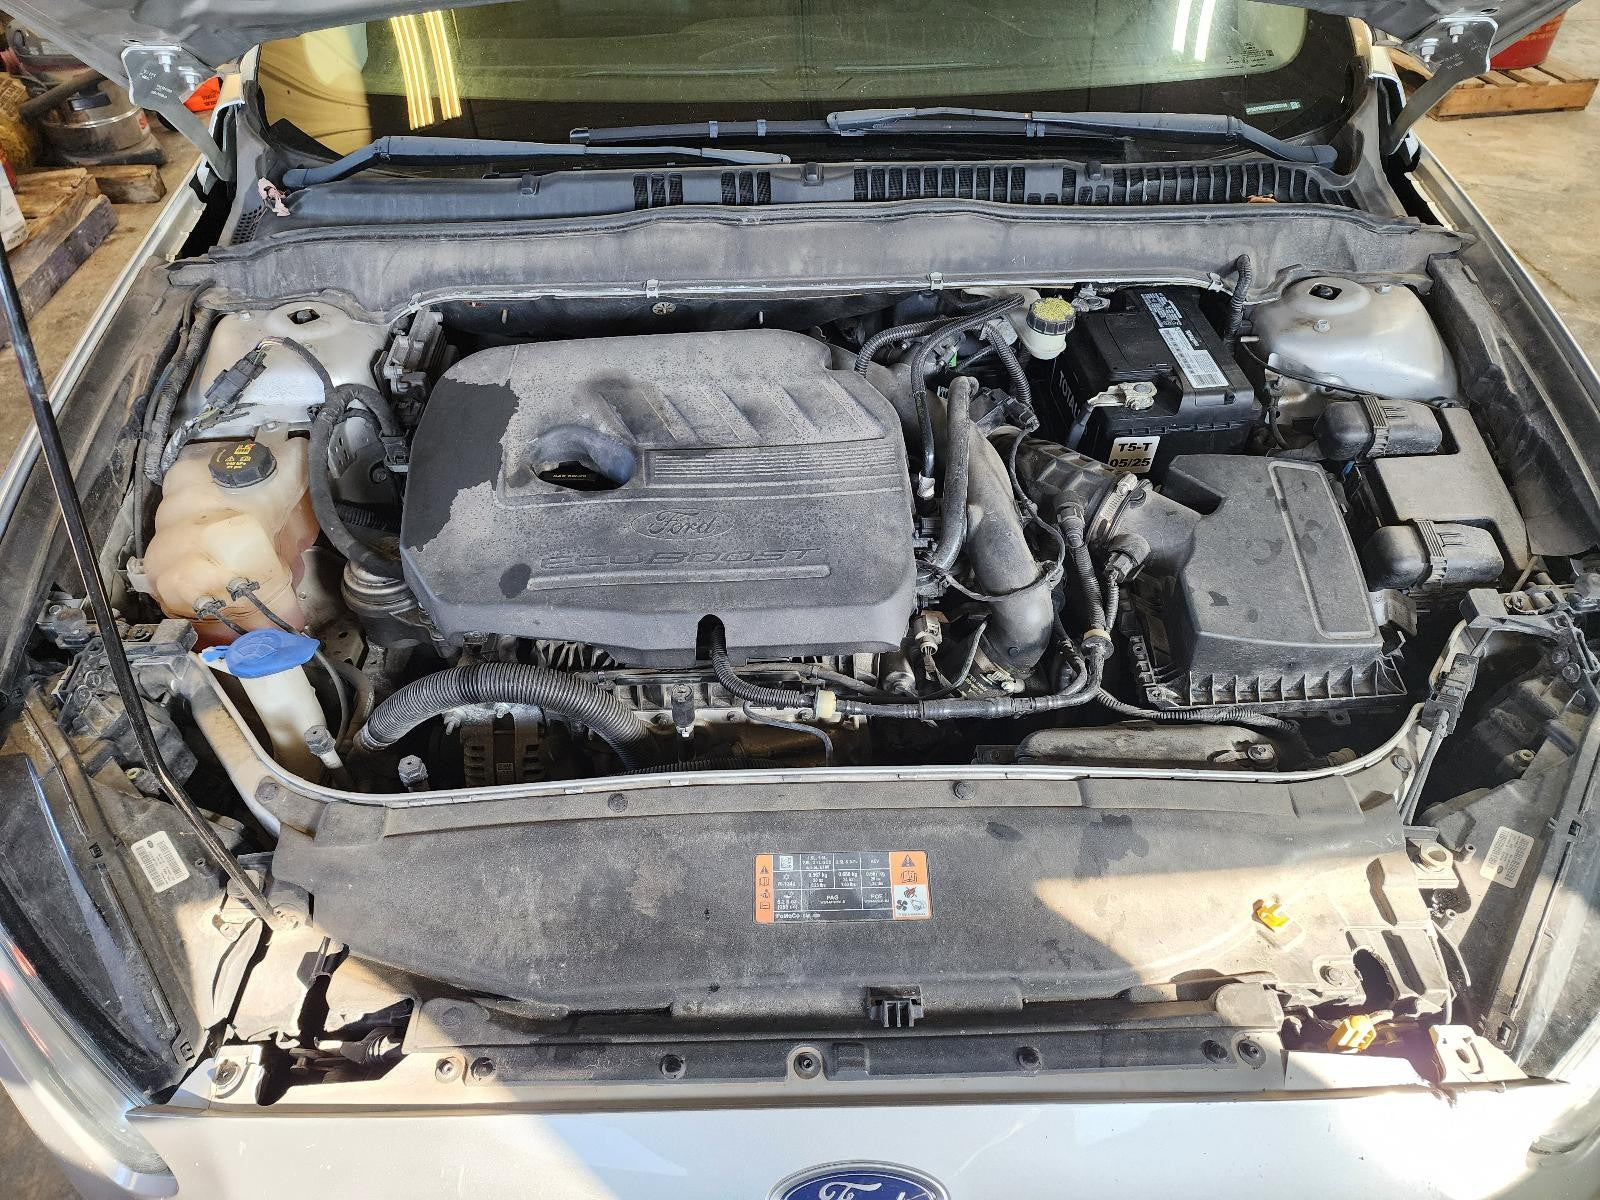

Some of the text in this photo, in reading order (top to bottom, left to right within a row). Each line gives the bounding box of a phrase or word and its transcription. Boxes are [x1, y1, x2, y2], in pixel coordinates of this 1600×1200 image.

[1118, 442, 1153, 452] T5-T
[1109, 458, 1152, 467] 05/25
[648, 508, 720, 535] Ford
[541, 548, 822, 570] ECOBOOST
